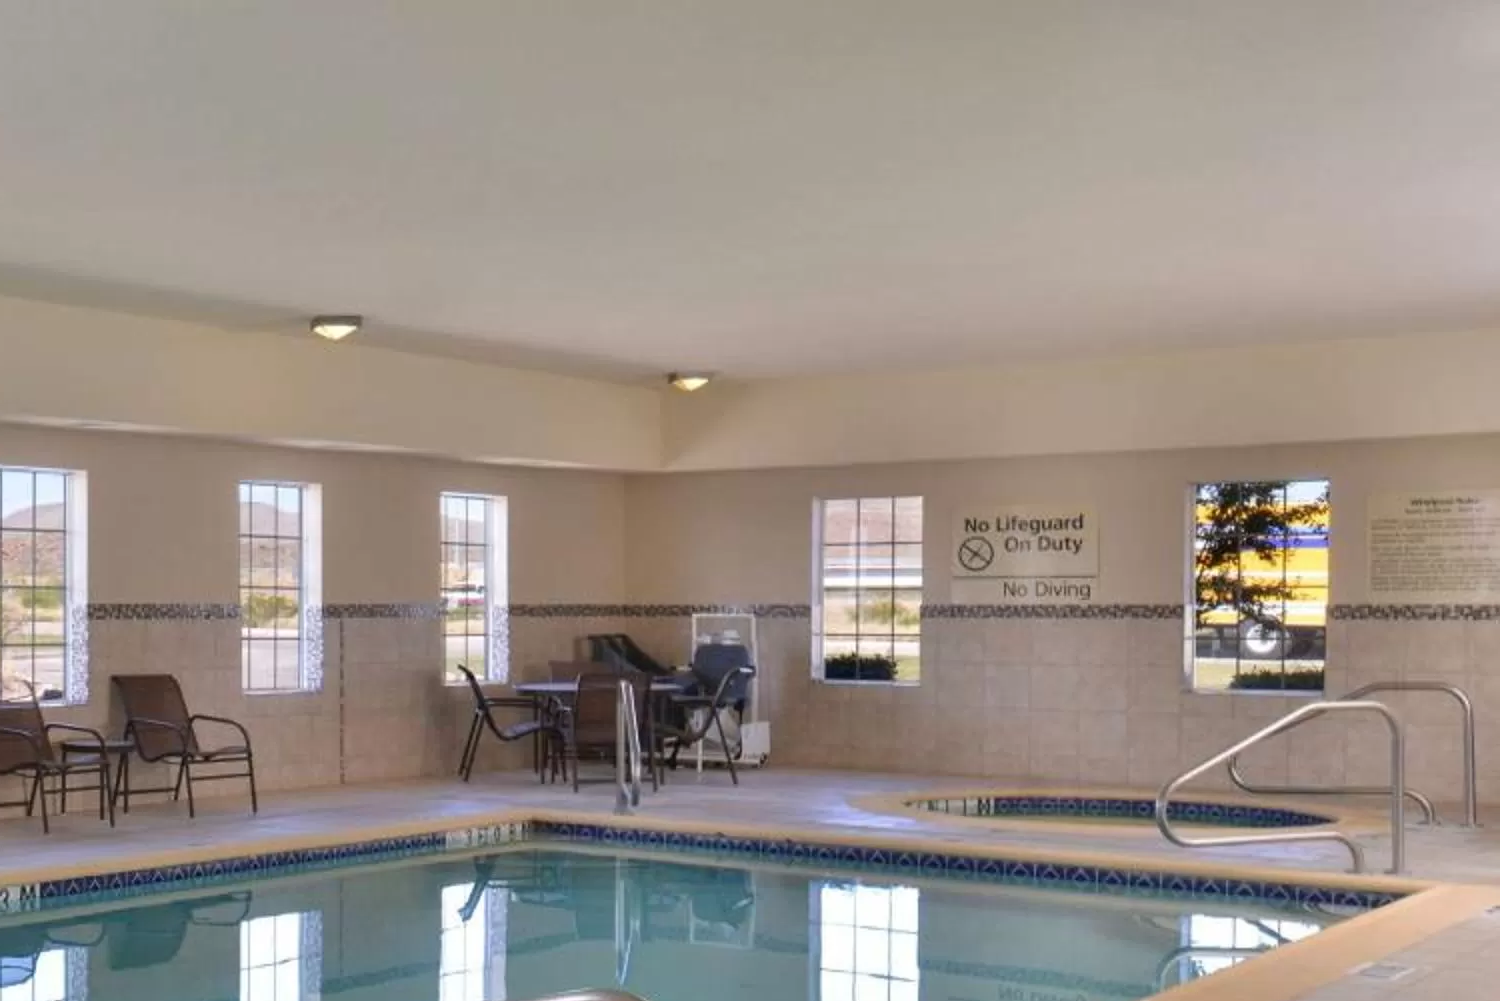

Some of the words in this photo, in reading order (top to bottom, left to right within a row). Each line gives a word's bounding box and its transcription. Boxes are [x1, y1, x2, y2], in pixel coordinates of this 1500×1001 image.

[964, 517, 990, 533] No
[996, 513, 1085, 535] Lifeguard
[1004, 536, 1031, 553] On
[1038, 536, 1083, 555] Duty
[1003, 581, 1028, 597] No
[1035, 581, 1092, 600] Diving
